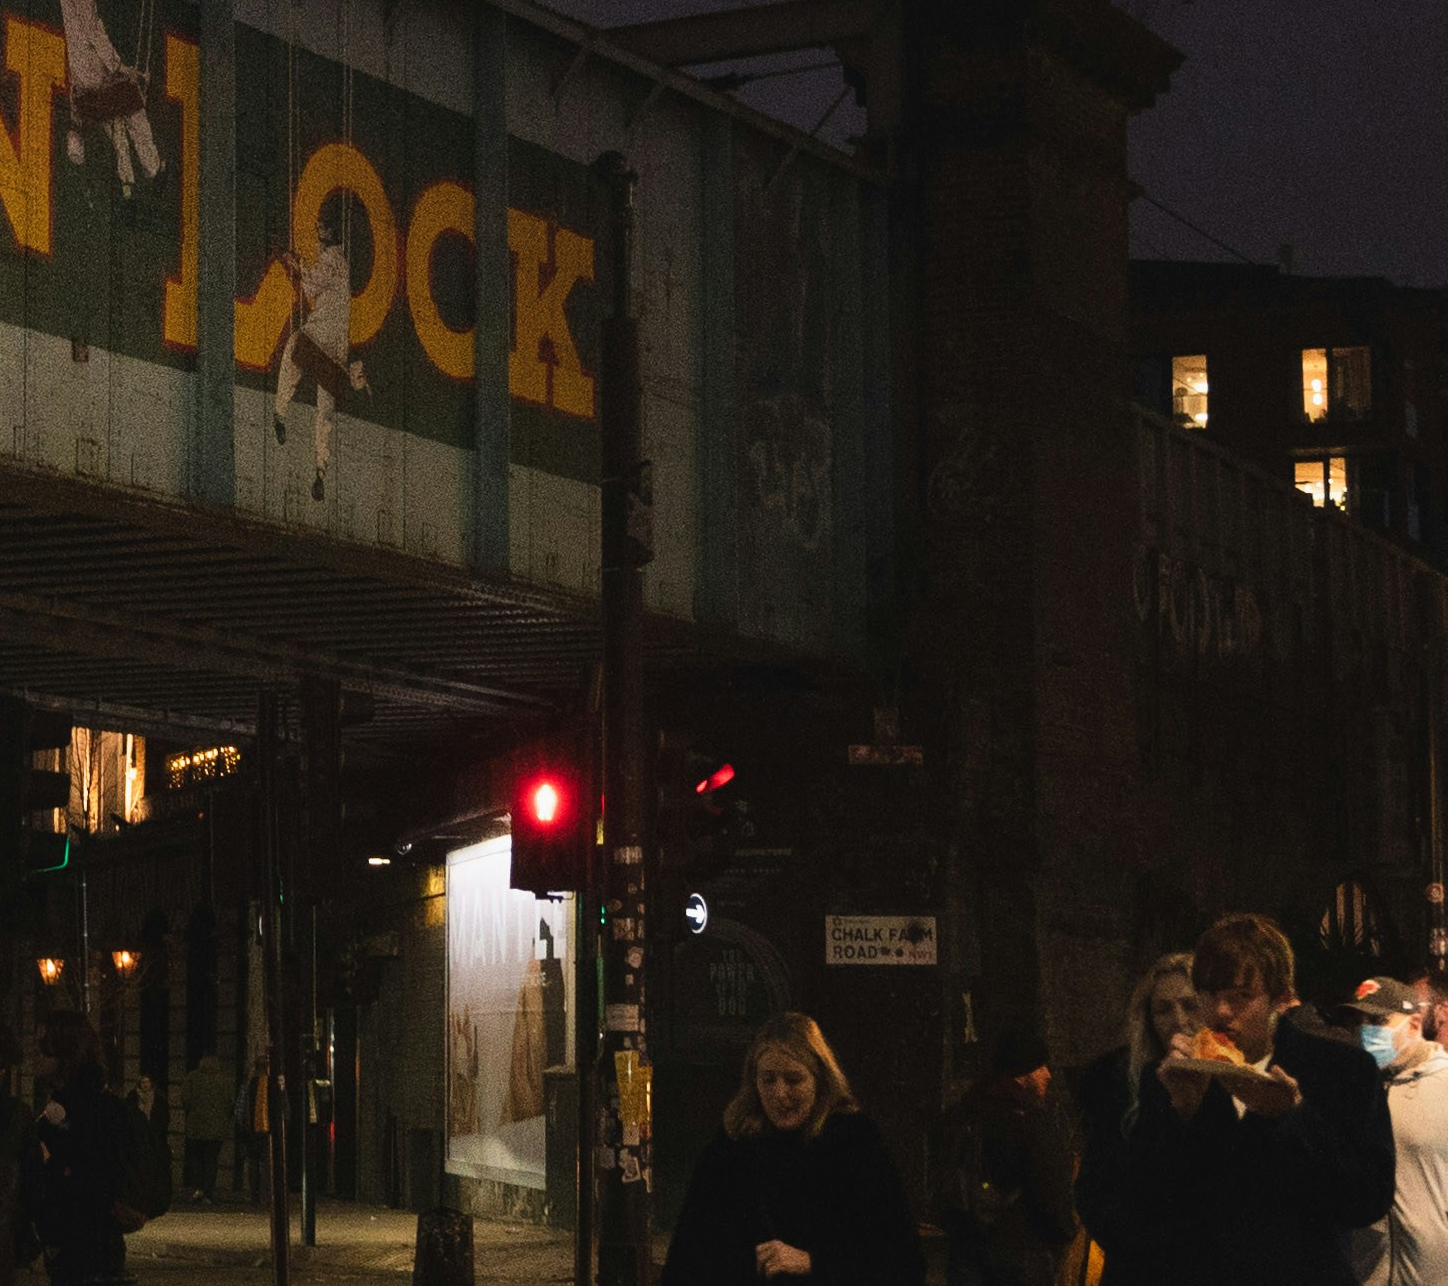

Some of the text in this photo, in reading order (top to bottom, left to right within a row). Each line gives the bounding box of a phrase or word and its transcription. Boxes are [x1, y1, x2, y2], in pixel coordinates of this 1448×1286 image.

[162, 31, 596, 419] LOCK
[831, 927, 933, 941] CHALK FAM
[833, 945, 878, 959] ROAD
